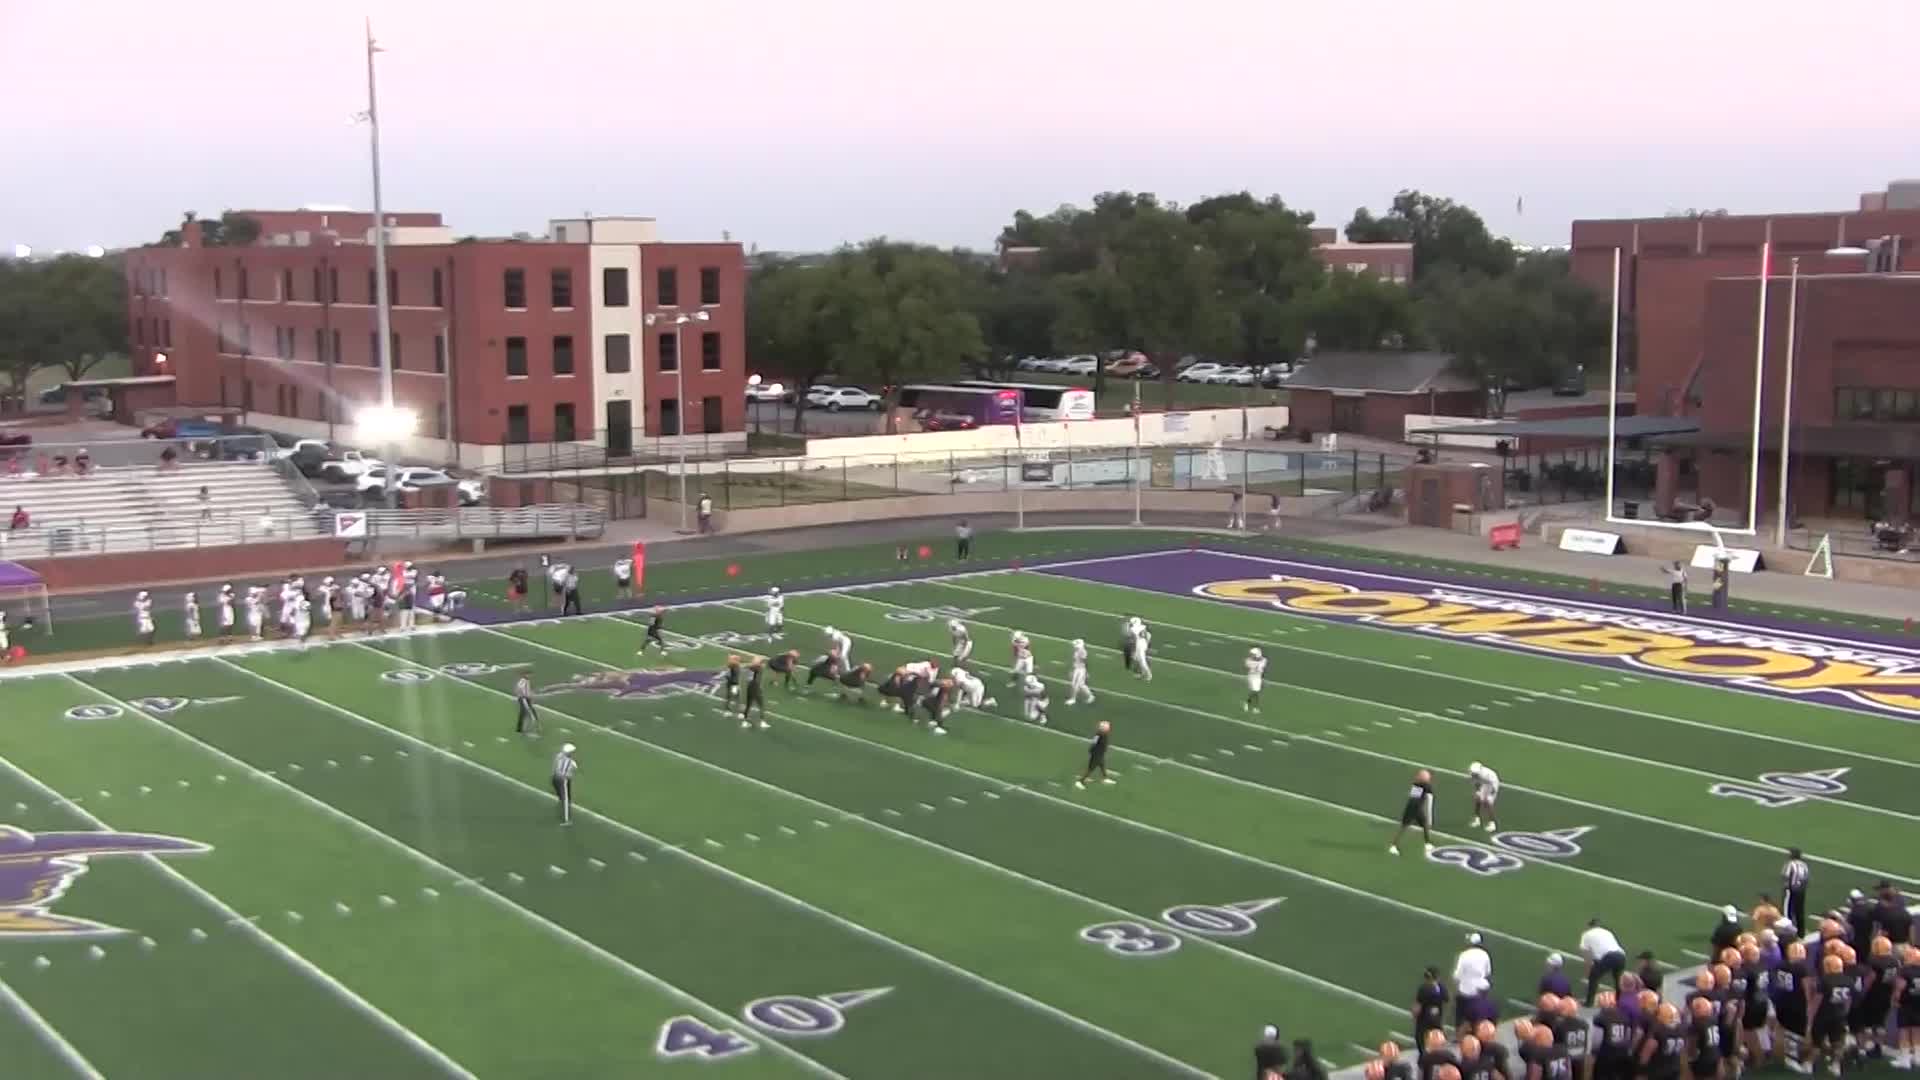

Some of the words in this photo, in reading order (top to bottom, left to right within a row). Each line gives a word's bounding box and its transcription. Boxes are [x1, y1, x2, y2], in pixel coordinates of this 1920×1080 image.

[1193, 574, 1920, 715] COWBOY
[1708, 772, 1848, 808] 10
[1425, 831, 1582, 876] 20
[1079, 904, 1257, 956] 30
[656, 995, 846, 1059] 40
[1707, 1025, 1720, 1047] 16
